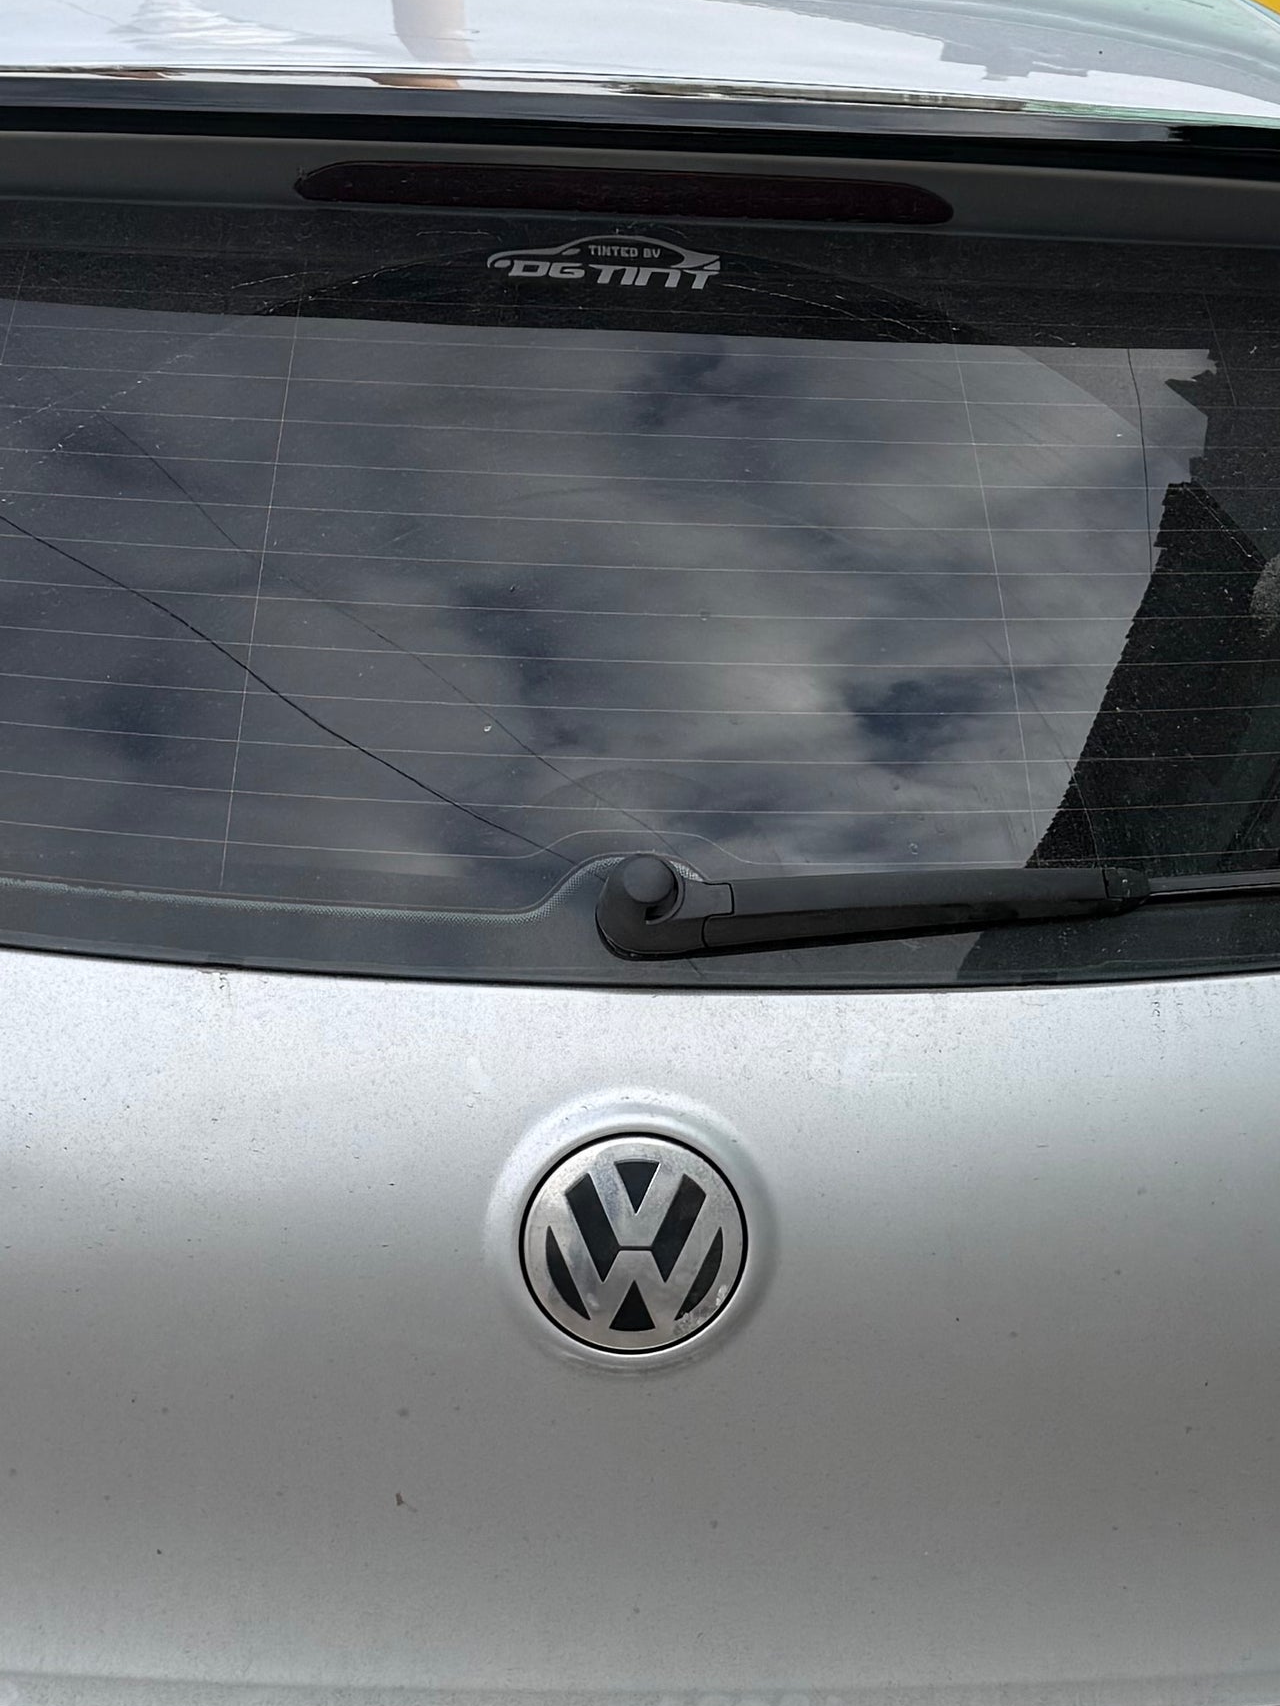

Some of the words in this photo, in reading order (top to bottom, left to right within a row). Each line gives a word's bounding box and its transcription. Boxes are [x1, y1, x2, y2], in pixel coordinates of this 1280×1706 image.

[588, 245, 639, 258] TINTED
[508, 259, 586, 279] DG
[589, 264, 720, 290] TINT
